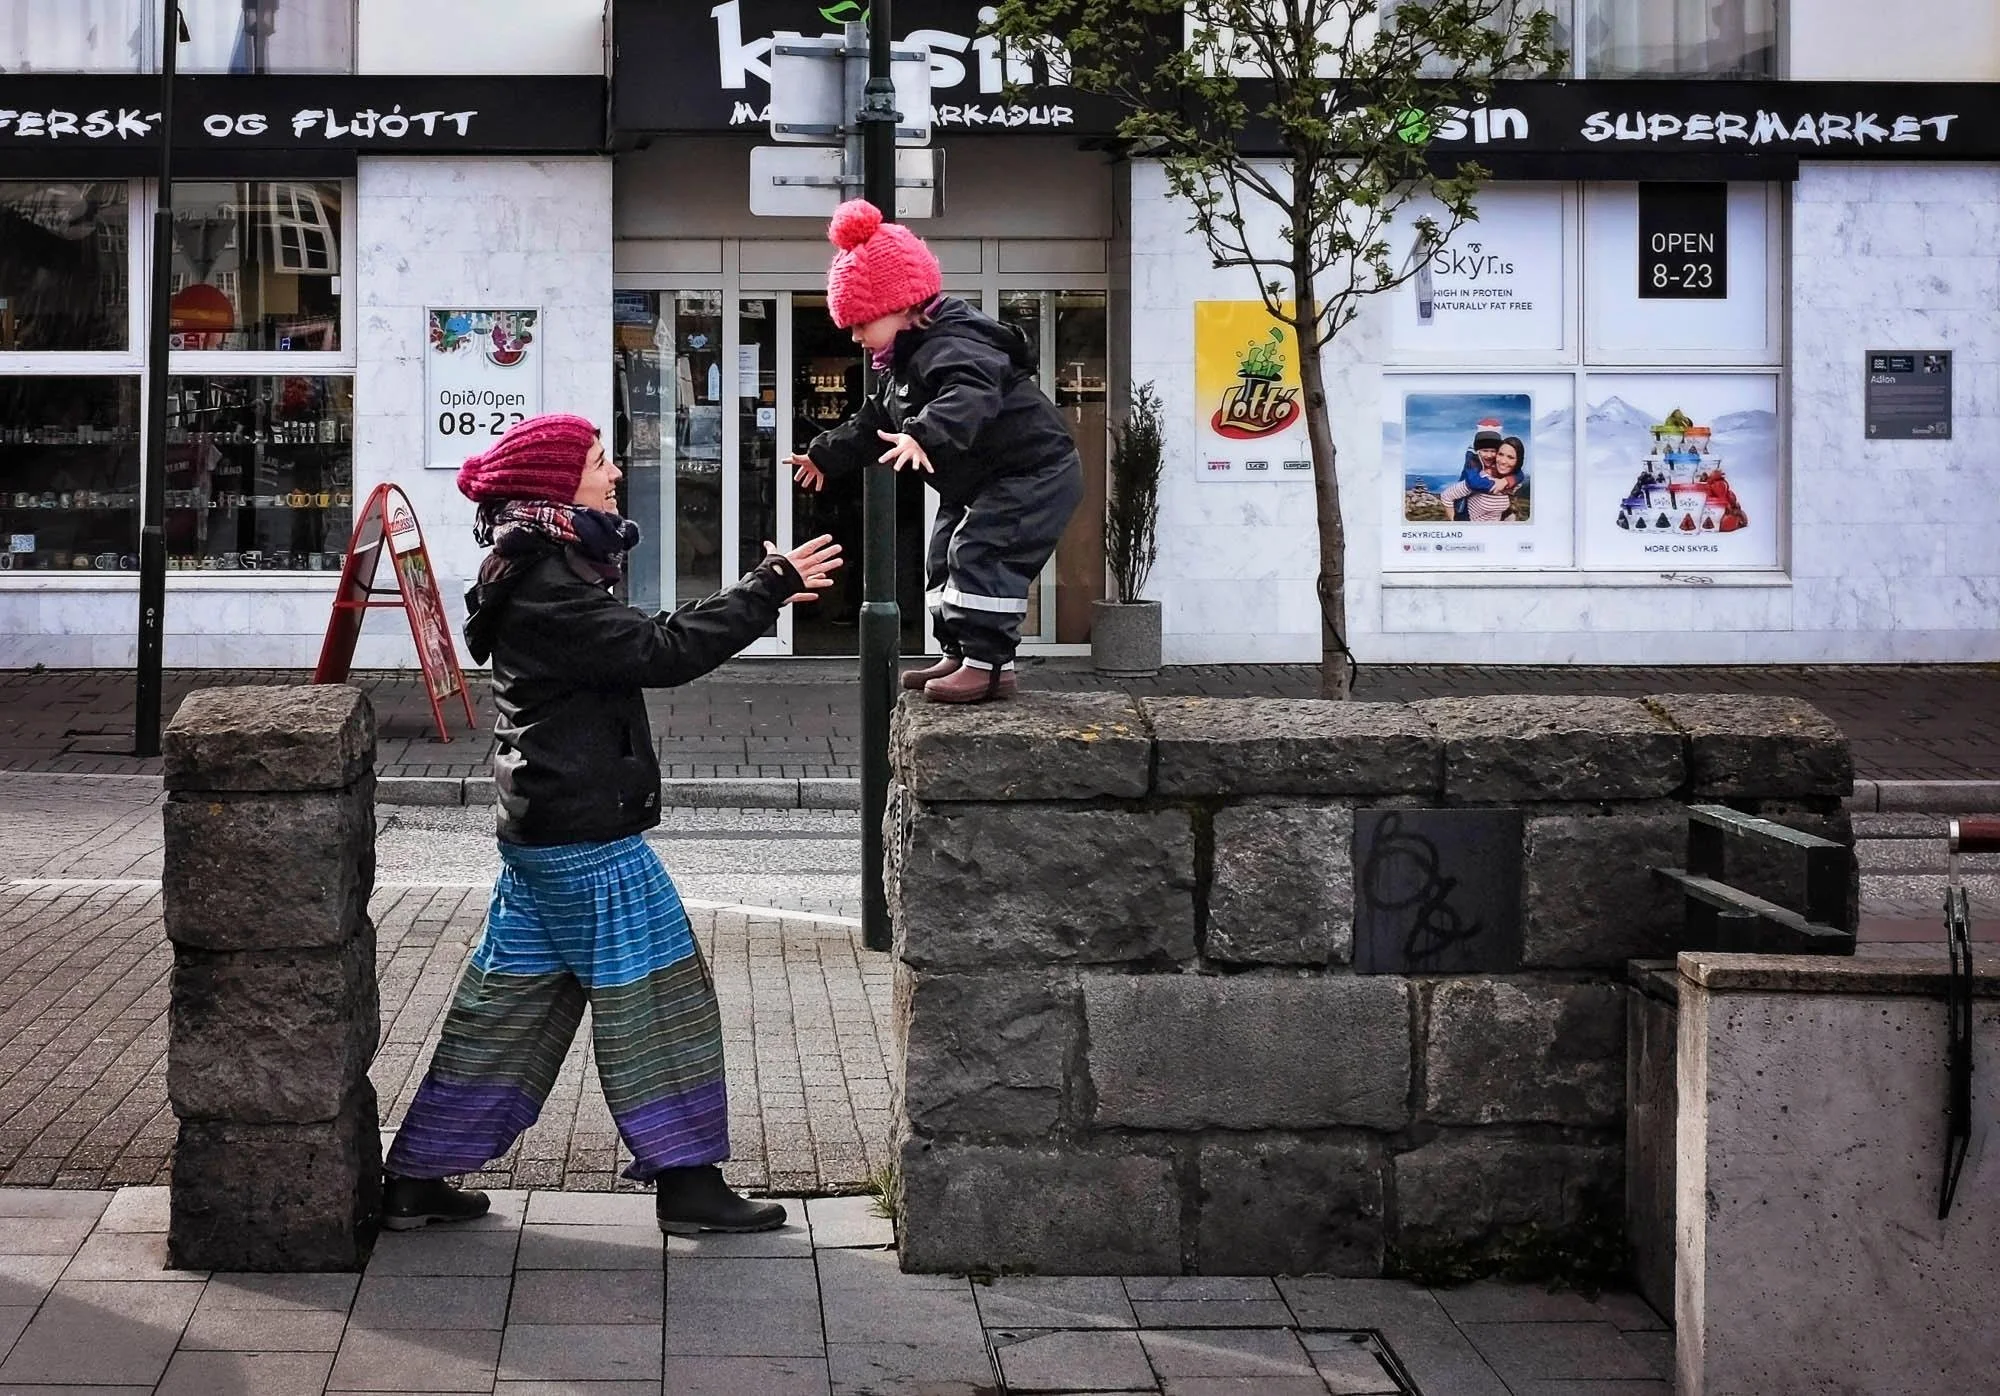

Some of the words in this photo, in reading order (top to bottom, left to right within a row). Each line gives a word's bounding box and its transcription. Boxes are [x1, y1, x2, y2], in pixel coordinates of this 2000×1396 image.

[711, 0, 1072, 94] ksin
[203, 113, 268, 138] OG
[291, 104, 478, 139] FLJÓTT
[1581, 109, 1958, 146] SUPERMARKET
[1651, 232, 1714, 253] OPEN
[1653, 263, 1713, 288] 8-23
[1433, 289, 1457, 297] HIGH
[1460, 289, 1470, 297] IN
[1472, 289, 1513, 297] PROTEIN
[1433, 302, 1487, 310] NATURALLY
[1490, 302, 1506, 310] FAT
[1509, 302, 1533, 310] FREE
[440, 390, 525, 409] Opið/Open
